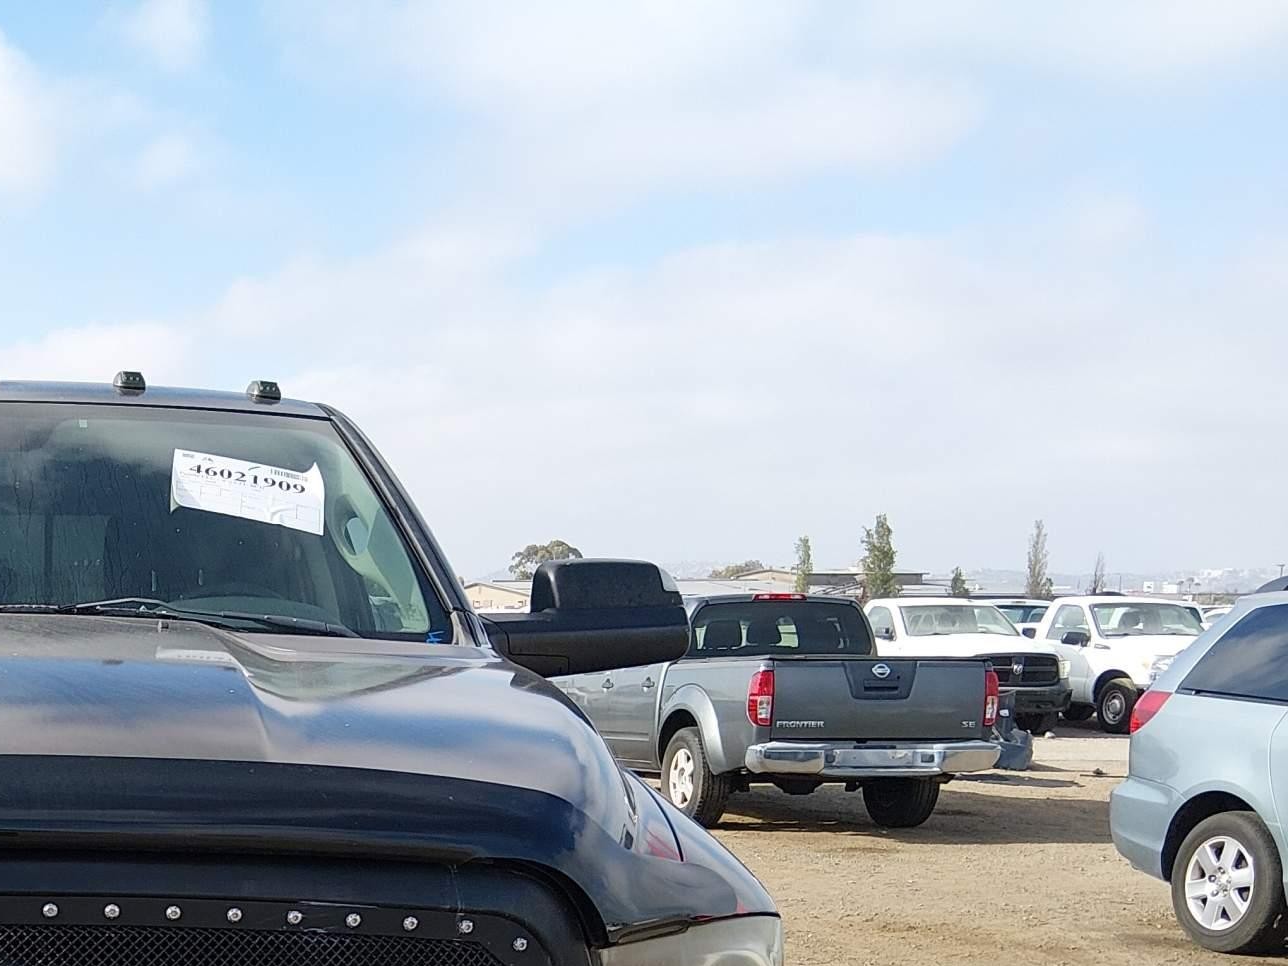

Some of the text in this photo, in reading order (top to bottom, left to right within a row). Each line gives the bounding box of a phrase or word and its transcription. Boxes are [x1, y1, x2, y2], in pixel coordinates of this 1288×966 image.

[189, 463, 306, 494] 46021909
[776, 720, 825, 728] FRONTIER
[961, 720, 976, 728] SE
